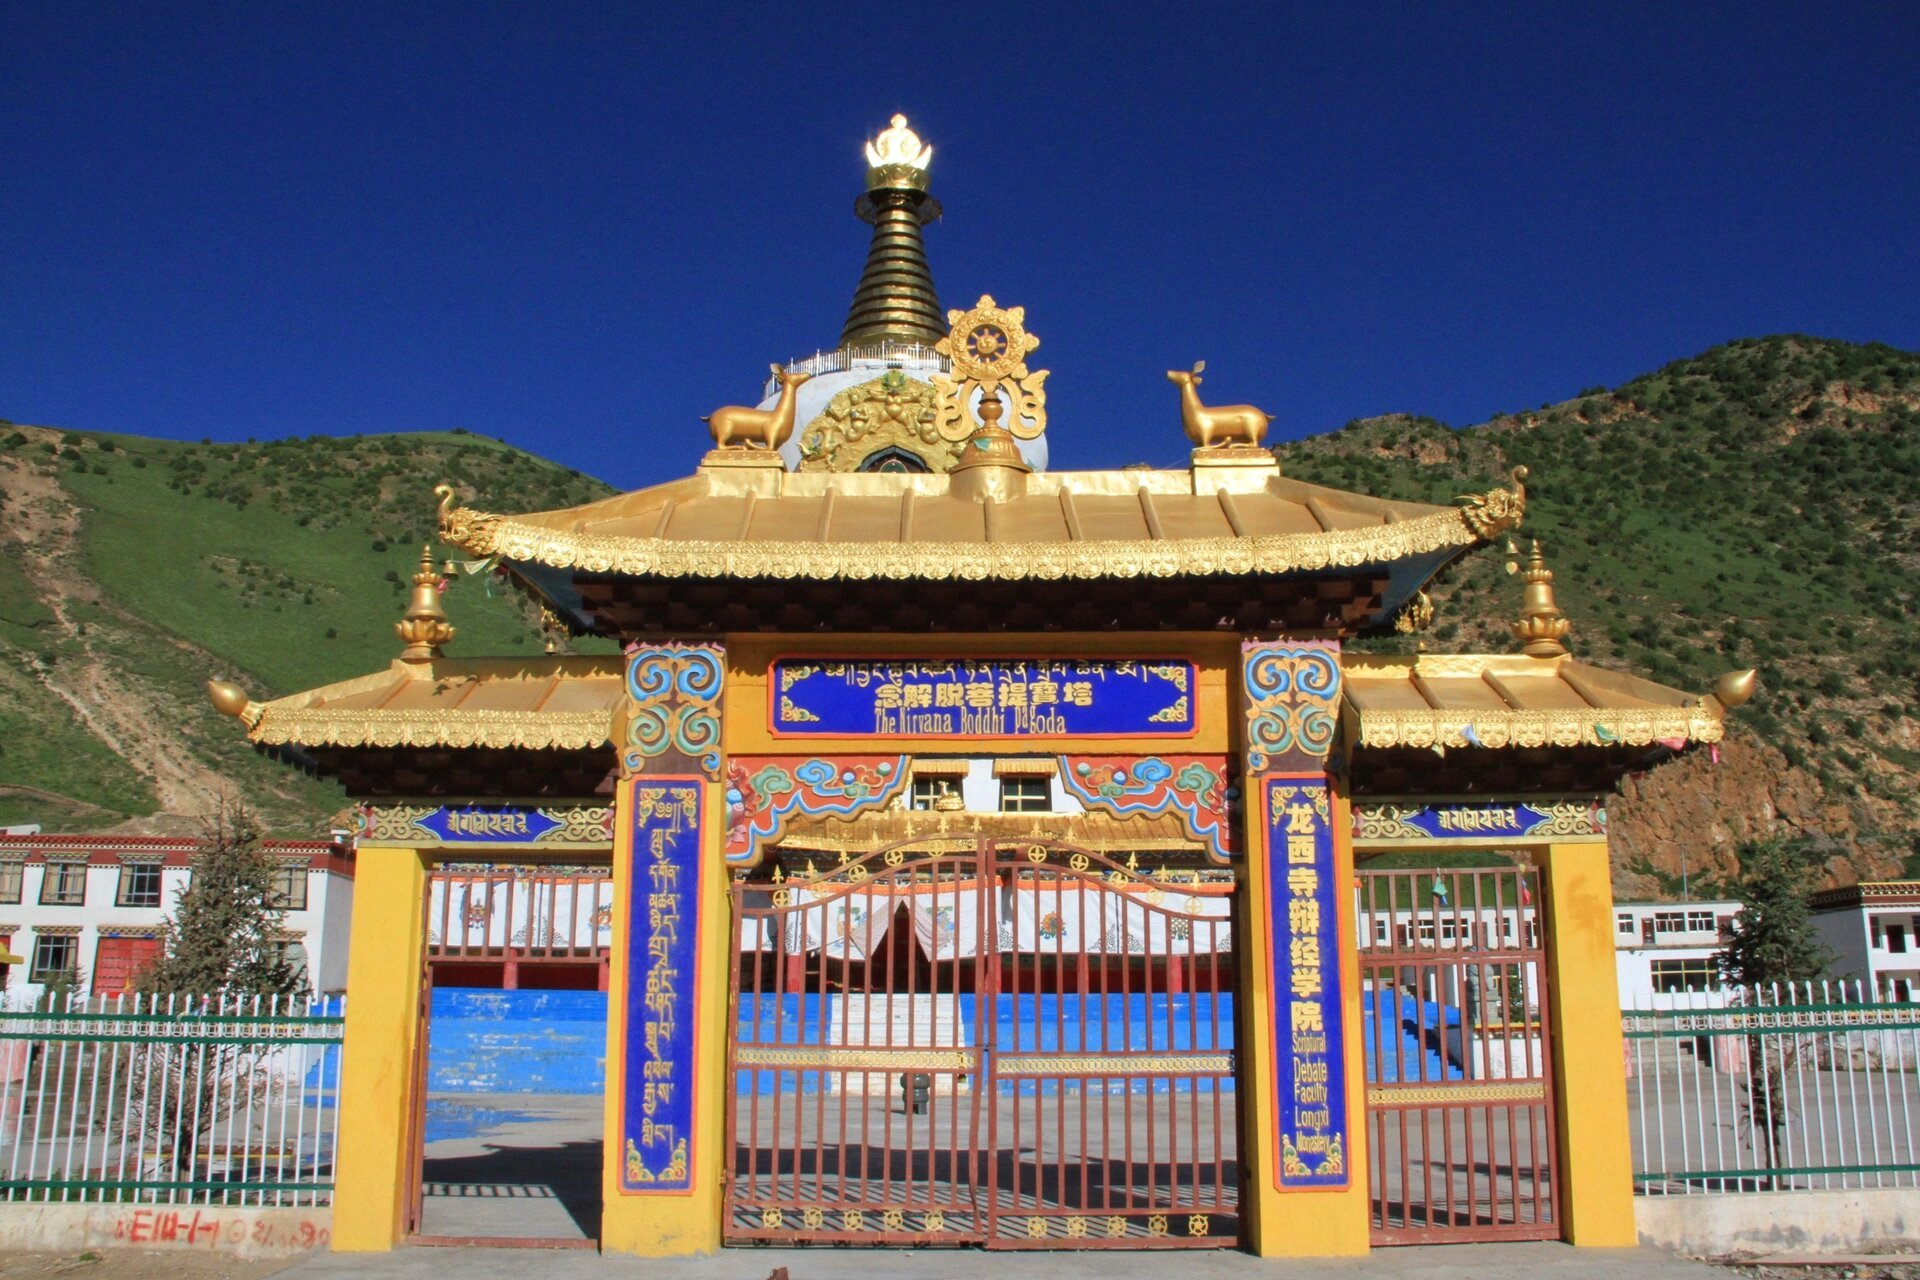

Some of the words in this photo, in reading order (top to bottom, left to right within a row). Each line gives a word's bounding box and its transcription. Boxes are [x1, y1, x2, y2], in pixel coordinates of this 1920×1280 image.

[875, 706, 896, 733] The
[900, 706, 952, 733] Nirvana
[961, 705, 1005, 734] Boddhi
[1285, 803, 1323, 1031] 龙西寺辩经学院
[1292, 1031, 1326, 1056] Scriptural
[1293, 1056, 1327, 1082] Debate
[1294, 1083, 1328, 1109] Faculty
[1295, 1105, 1329, 1131] Longxi
[1296, 1130, 1330, 1152] Monastery
